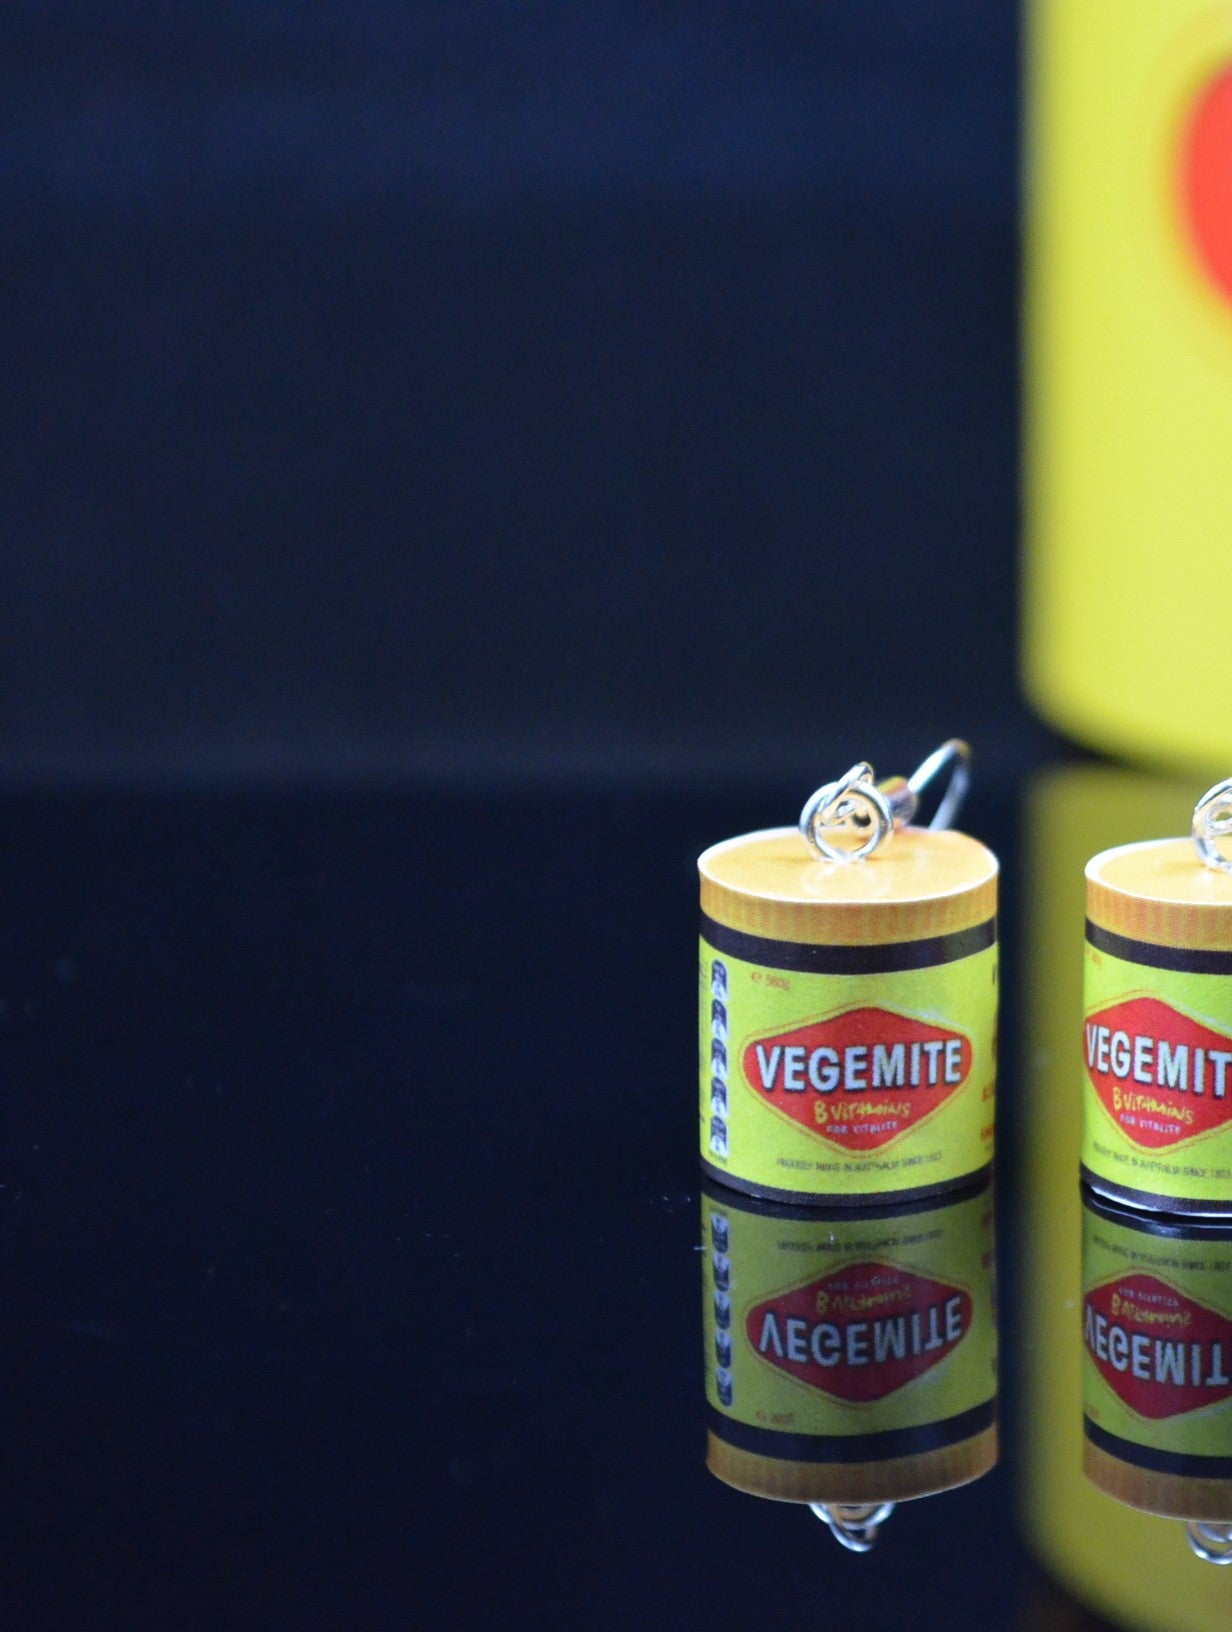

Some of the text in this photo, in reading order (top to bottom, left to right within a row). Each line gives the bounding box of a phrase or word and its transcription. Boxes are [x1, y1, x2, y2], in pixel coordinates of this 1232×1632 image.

[755, 1039, 963, 1094] VEGEMITE
[1112, 1086, 1123, 1111] B
[814, 1099, 828, 1124] B
